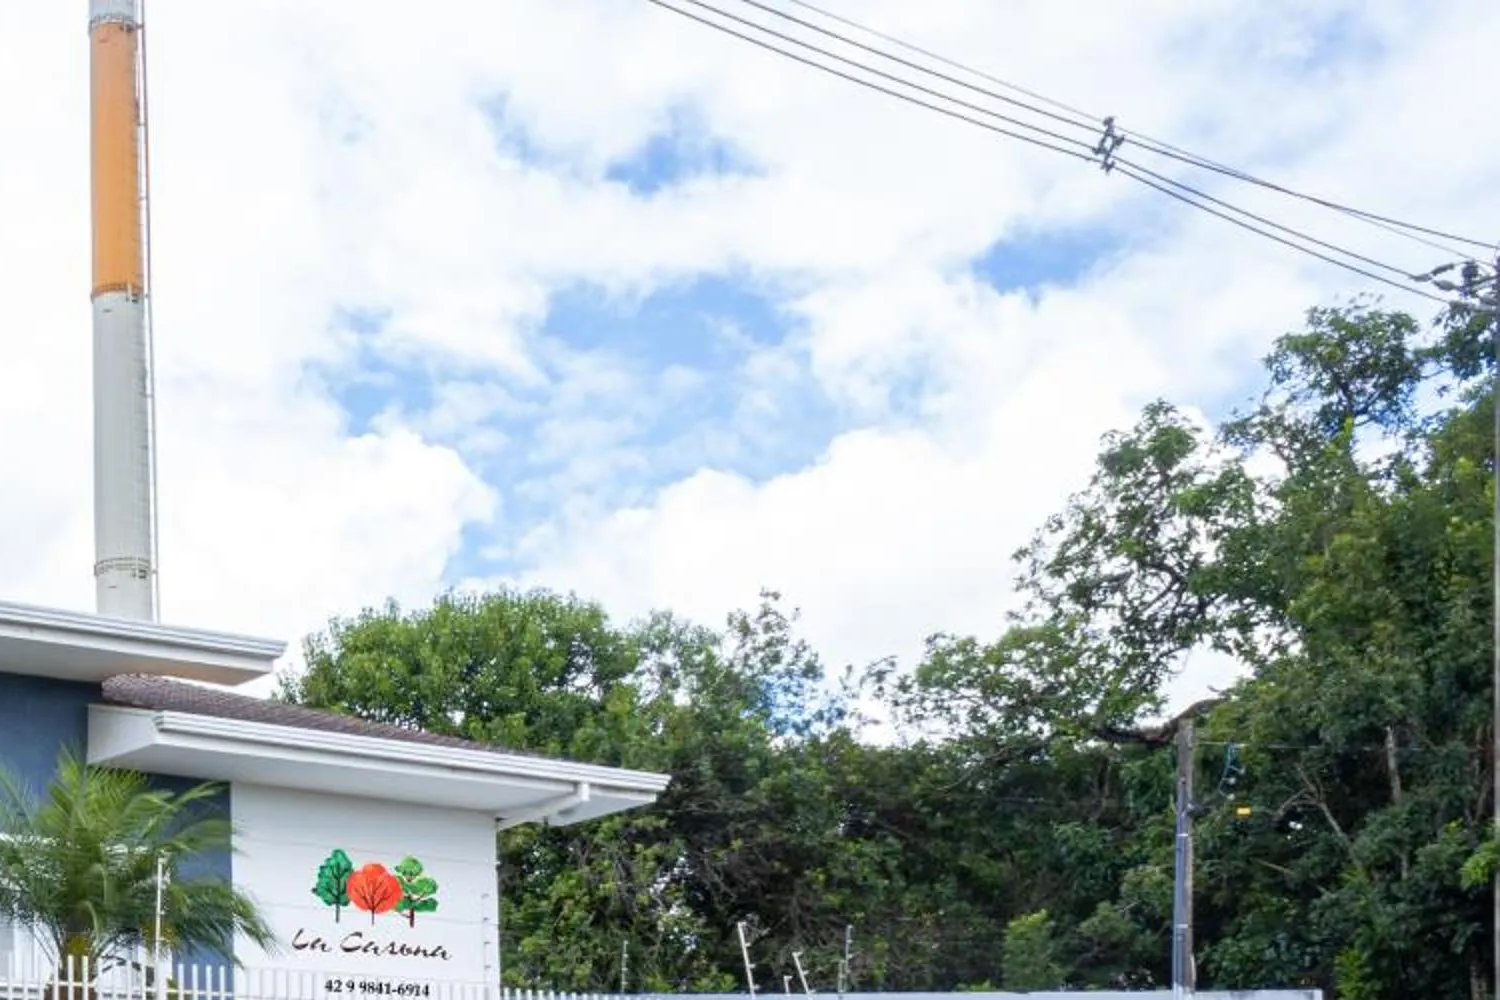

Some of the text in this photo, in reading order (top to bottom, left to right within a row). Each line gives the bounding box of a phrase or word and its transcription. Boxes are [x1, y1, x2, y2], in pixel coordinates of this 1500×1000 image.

[292, 928, 452, 960] La Casona
[324, 979, 342, 993] 42
[346, 979, 355, 993] 9
